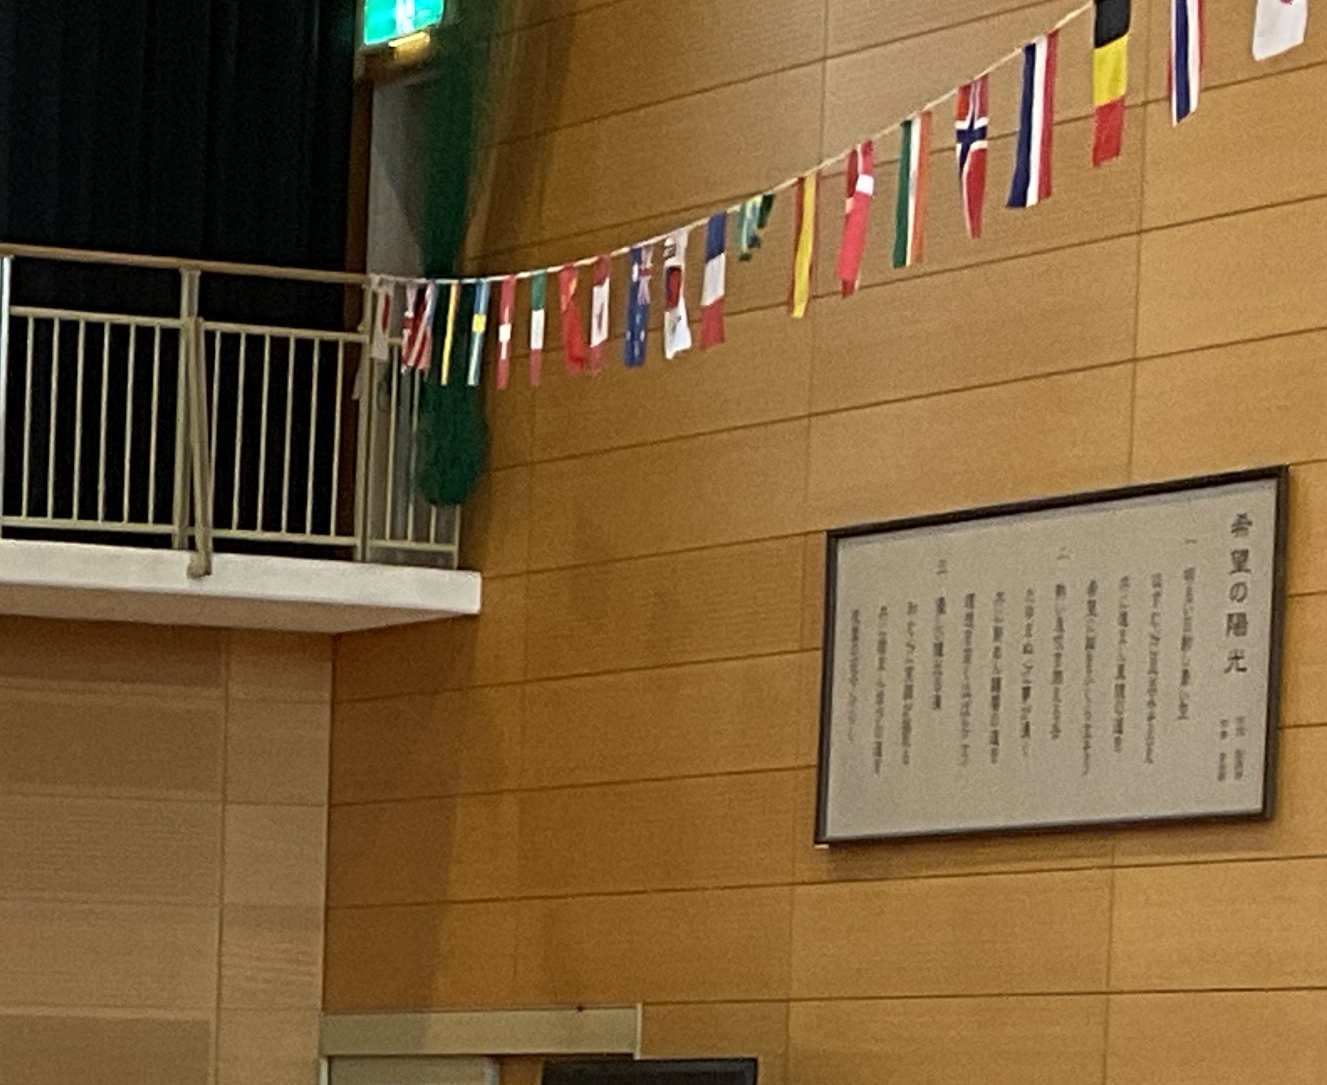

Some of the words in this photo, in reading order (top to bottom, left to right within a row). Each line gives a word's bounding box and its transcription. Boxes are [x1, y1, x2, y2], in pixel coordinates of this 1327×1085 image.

[1223, 511, 1253, 675] 希望の陽光
